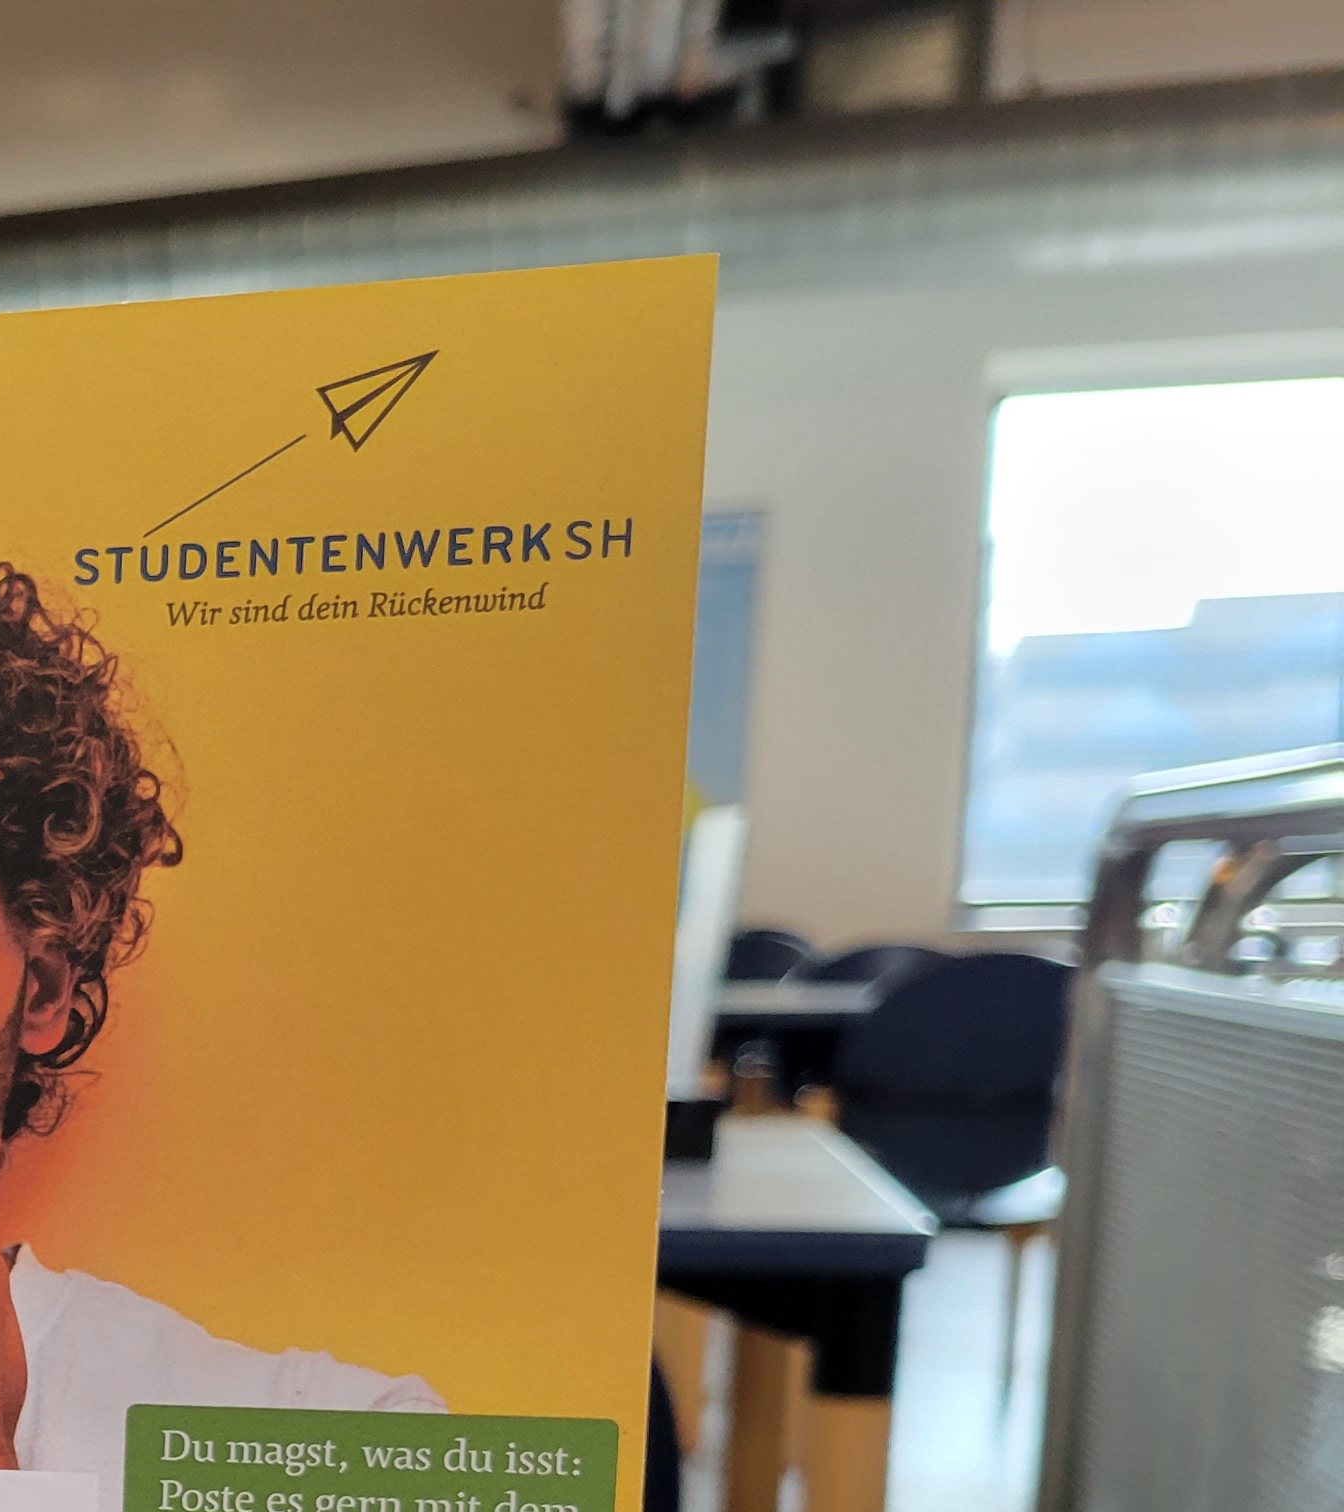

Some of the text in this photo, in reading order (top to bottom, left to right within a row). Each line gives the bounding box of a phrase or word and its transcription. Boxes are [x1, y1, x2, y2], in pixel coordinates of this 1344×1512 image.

[167, 582, 550, 626] Wir sind dein Rückenwind
[161, 1429, 582, 1477] Du magst, was du isst:
